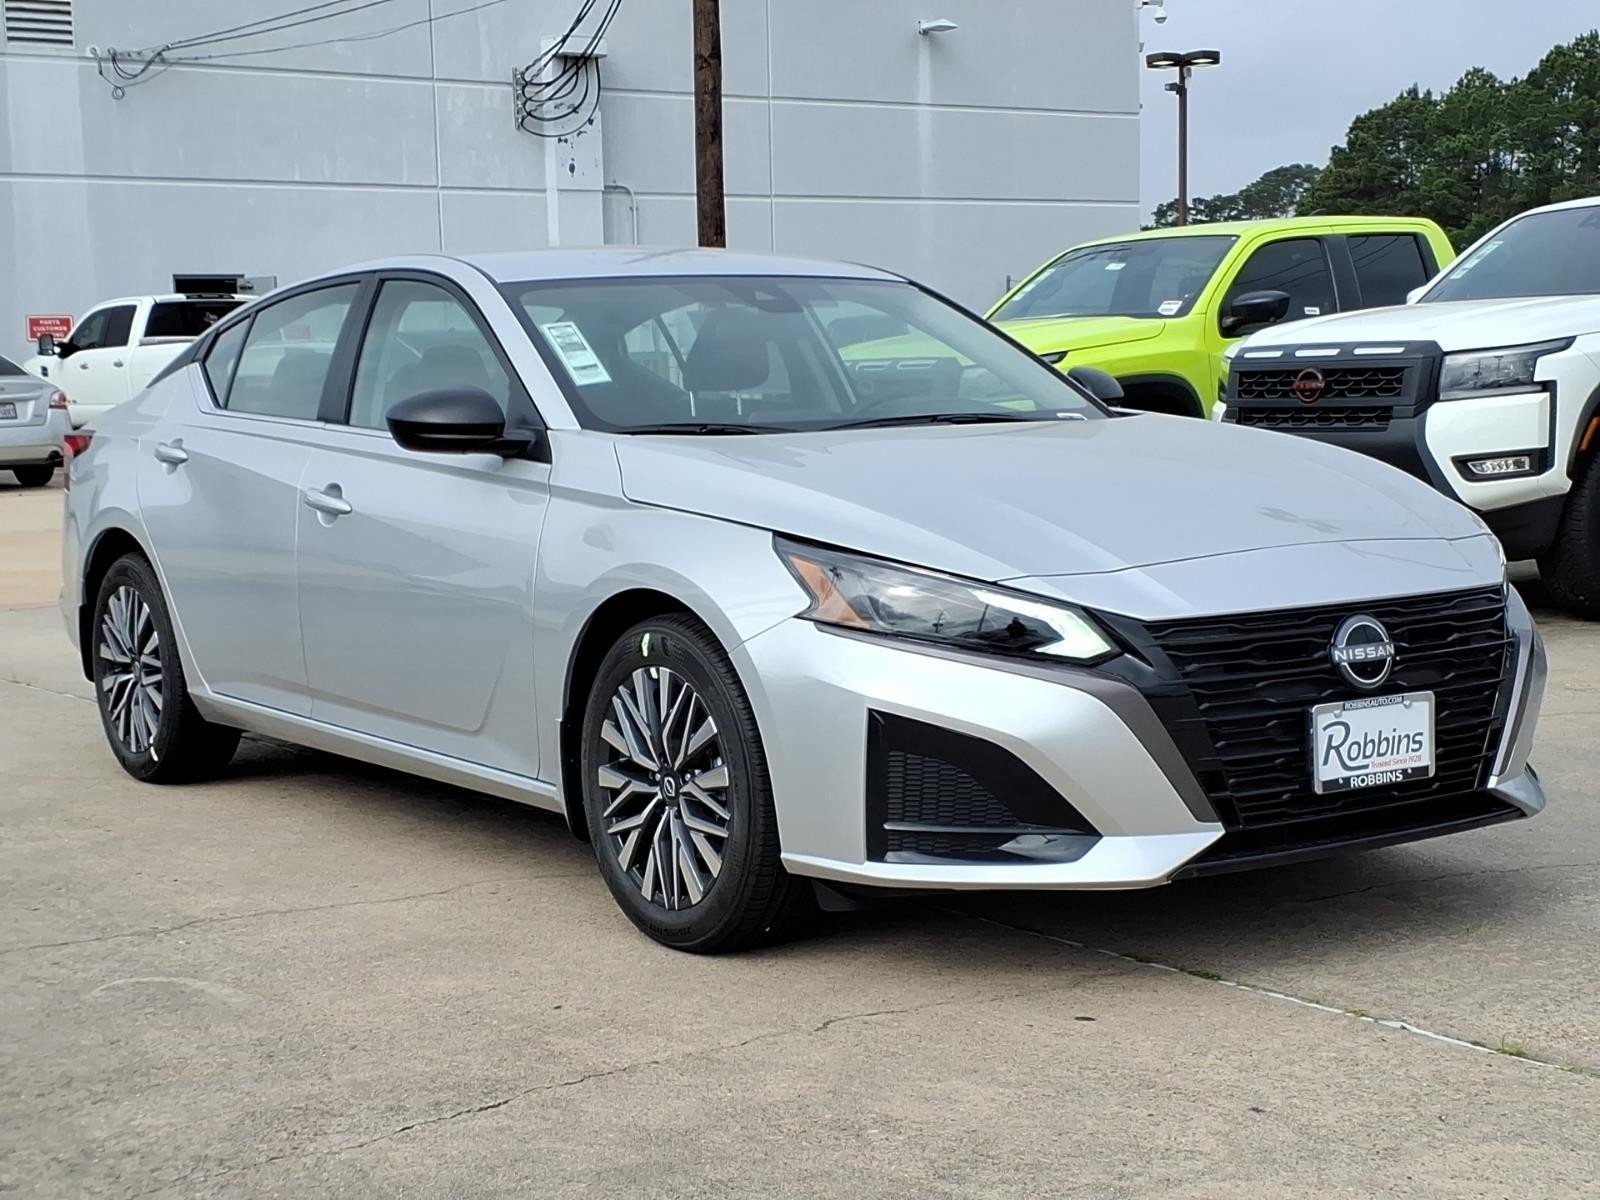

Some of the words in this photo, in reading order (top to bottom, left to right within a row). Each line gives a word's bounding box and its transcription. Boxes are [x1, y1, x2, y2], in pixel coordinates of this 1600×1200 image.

[1334, 643, 1395, 662] NISSAN
[1344, 696, 1403, 711] ROBBINSAUTO.COM
[1322, 720, 1424, 772] Robbins
[1371, 758, 1392, 769] Trusted
[1392, 755, 1408, 767] Since
[1408, 753, 1422, 764] 1928
[1350, 769, 1404, 789] ROBBINS
